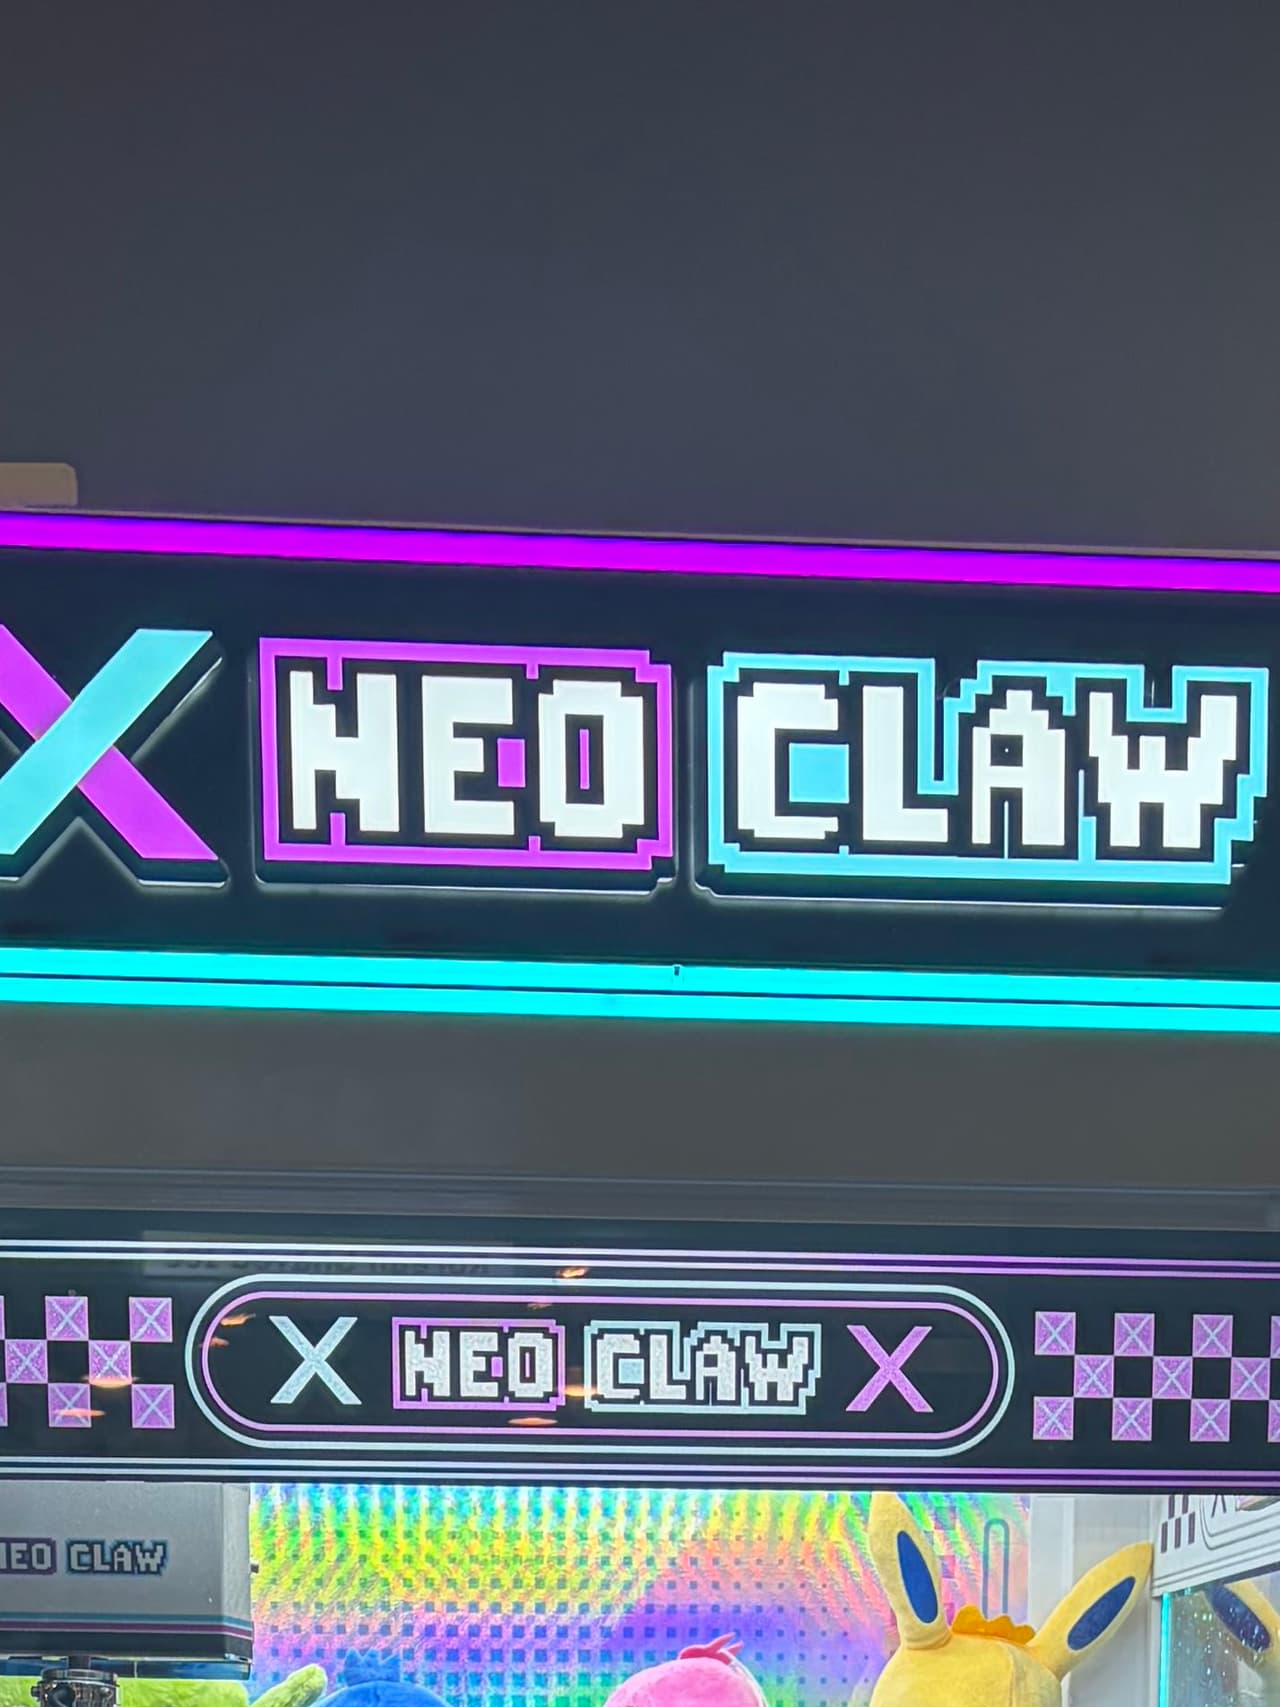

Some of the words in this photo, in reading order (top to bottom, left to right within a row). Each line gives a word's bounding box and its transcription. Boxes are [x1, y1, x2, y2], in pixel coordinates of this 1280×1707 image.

[280, 652, 659, 859] NEO
[720, 667, 1260, 866] CLAW
[397, 1322, 563, 1407] NEO
[588, 1325, 818, 1410] CLAW
[67, 1539, 166, 1576] CLAW
